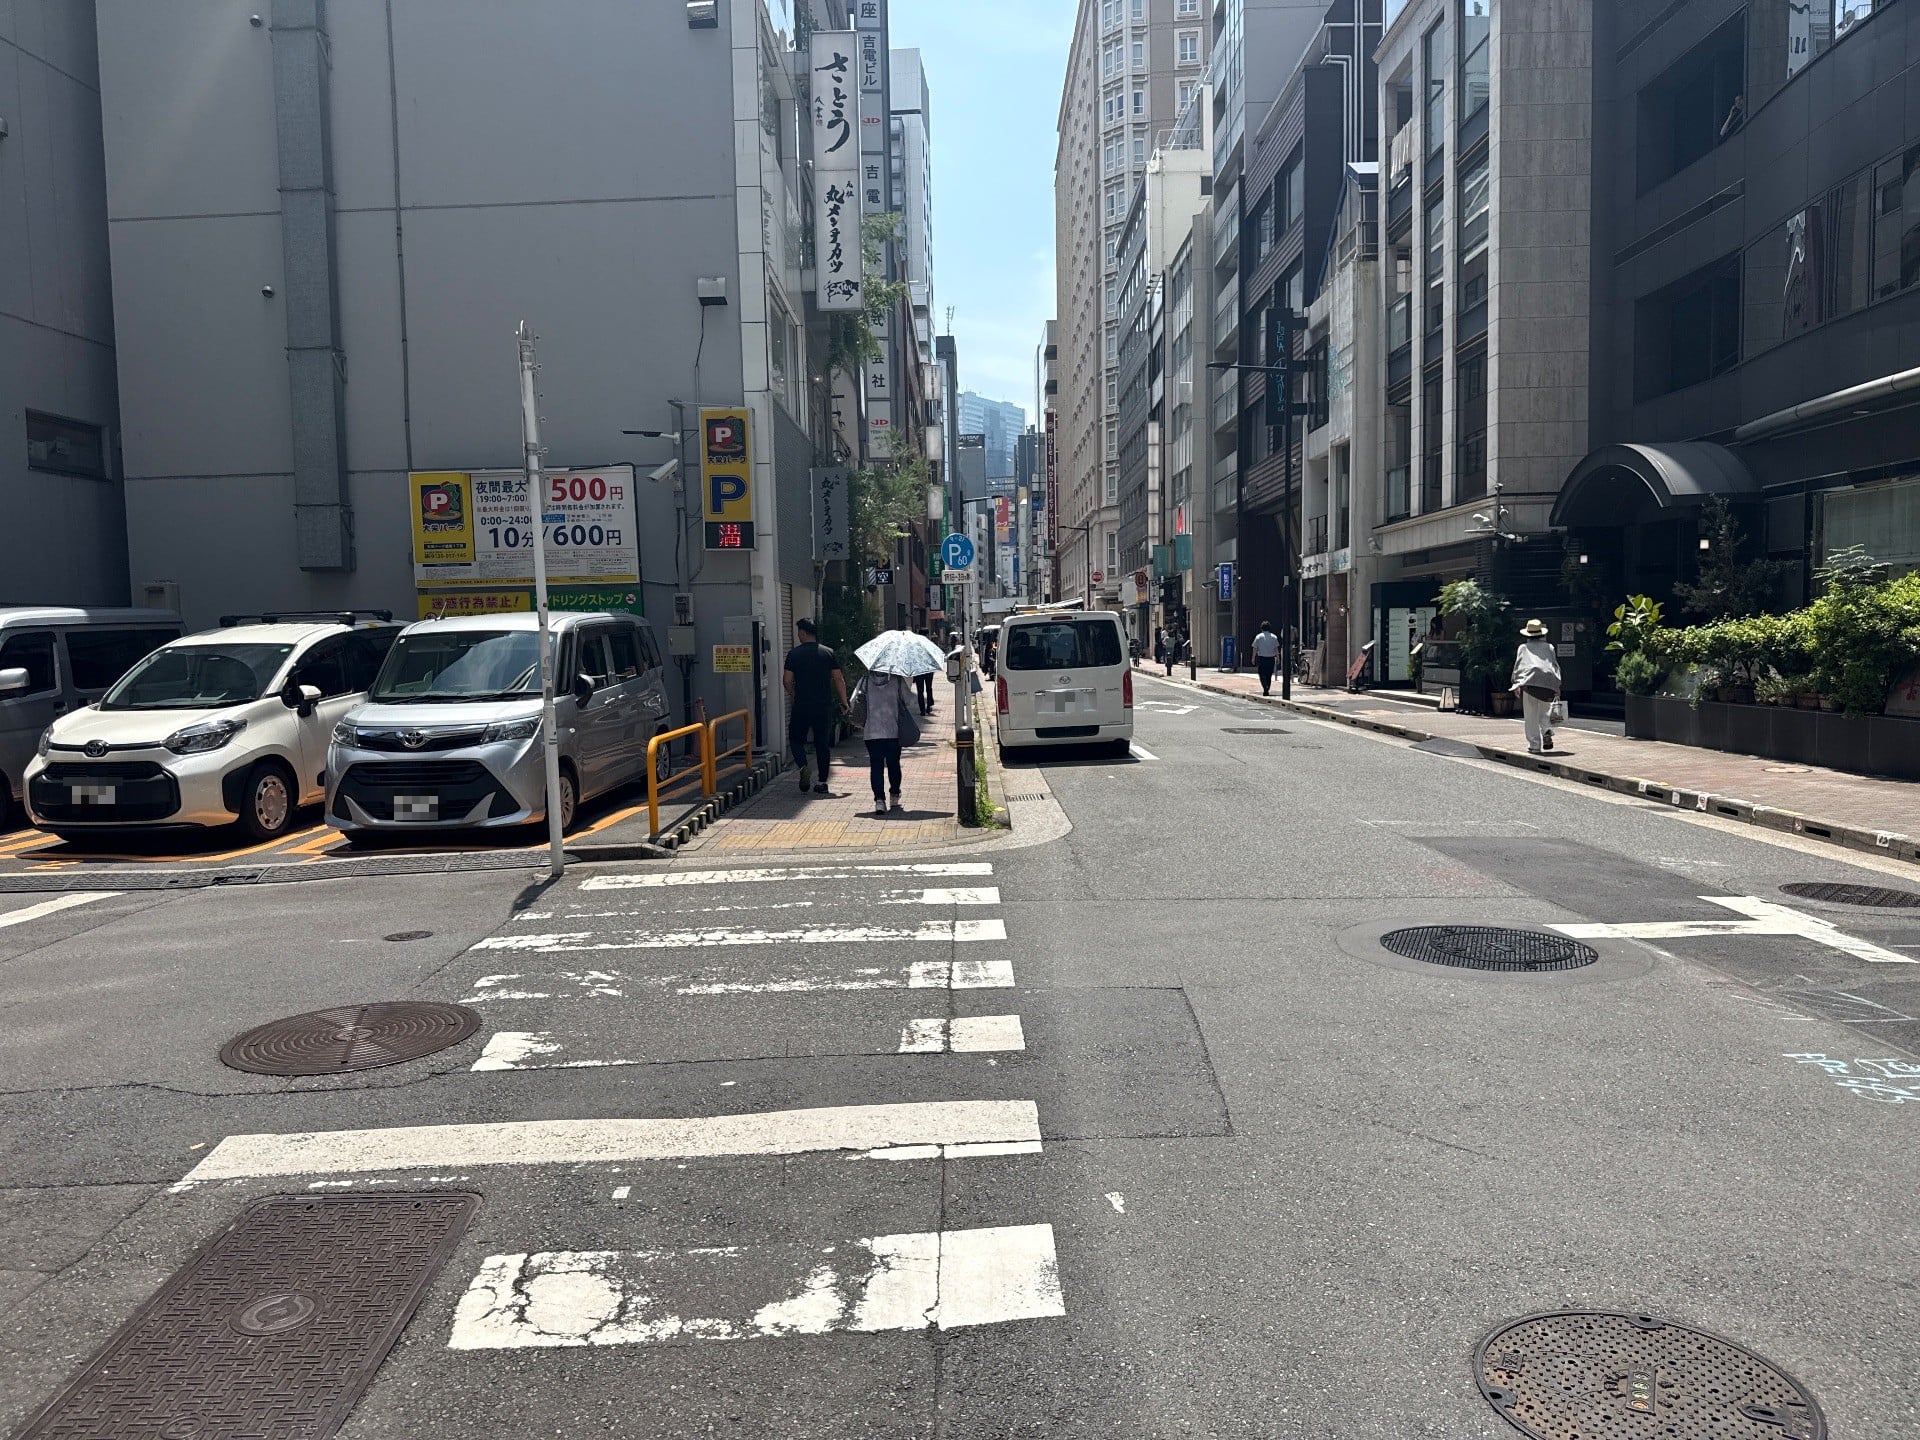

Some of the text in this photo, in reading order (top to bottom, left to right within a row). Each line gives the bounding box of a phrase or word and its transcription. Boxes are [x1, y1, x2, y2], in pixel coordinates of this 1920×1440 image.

[861, 2, 877, 18] 座
[862, 35, 877, 86] 吉電ビル
[815, 52, 850, 153] さとう
[865, 165, 881, 203] 吉電
[824, 185, 844, 273] 丸メンチカツ
[715, 427, 732, 443] P
[475, 477, 624, 502] 夜間最大 500円
[709, 475, 747, 514] P
[430, 493, 448, 510] P
[481, 516, 533, 526] 0:00~24:0
[719, 524, 741, 547] 満
[948, 543, 962, 566] P
[431, 596, 519, 609] 迷惑行為禁止!
